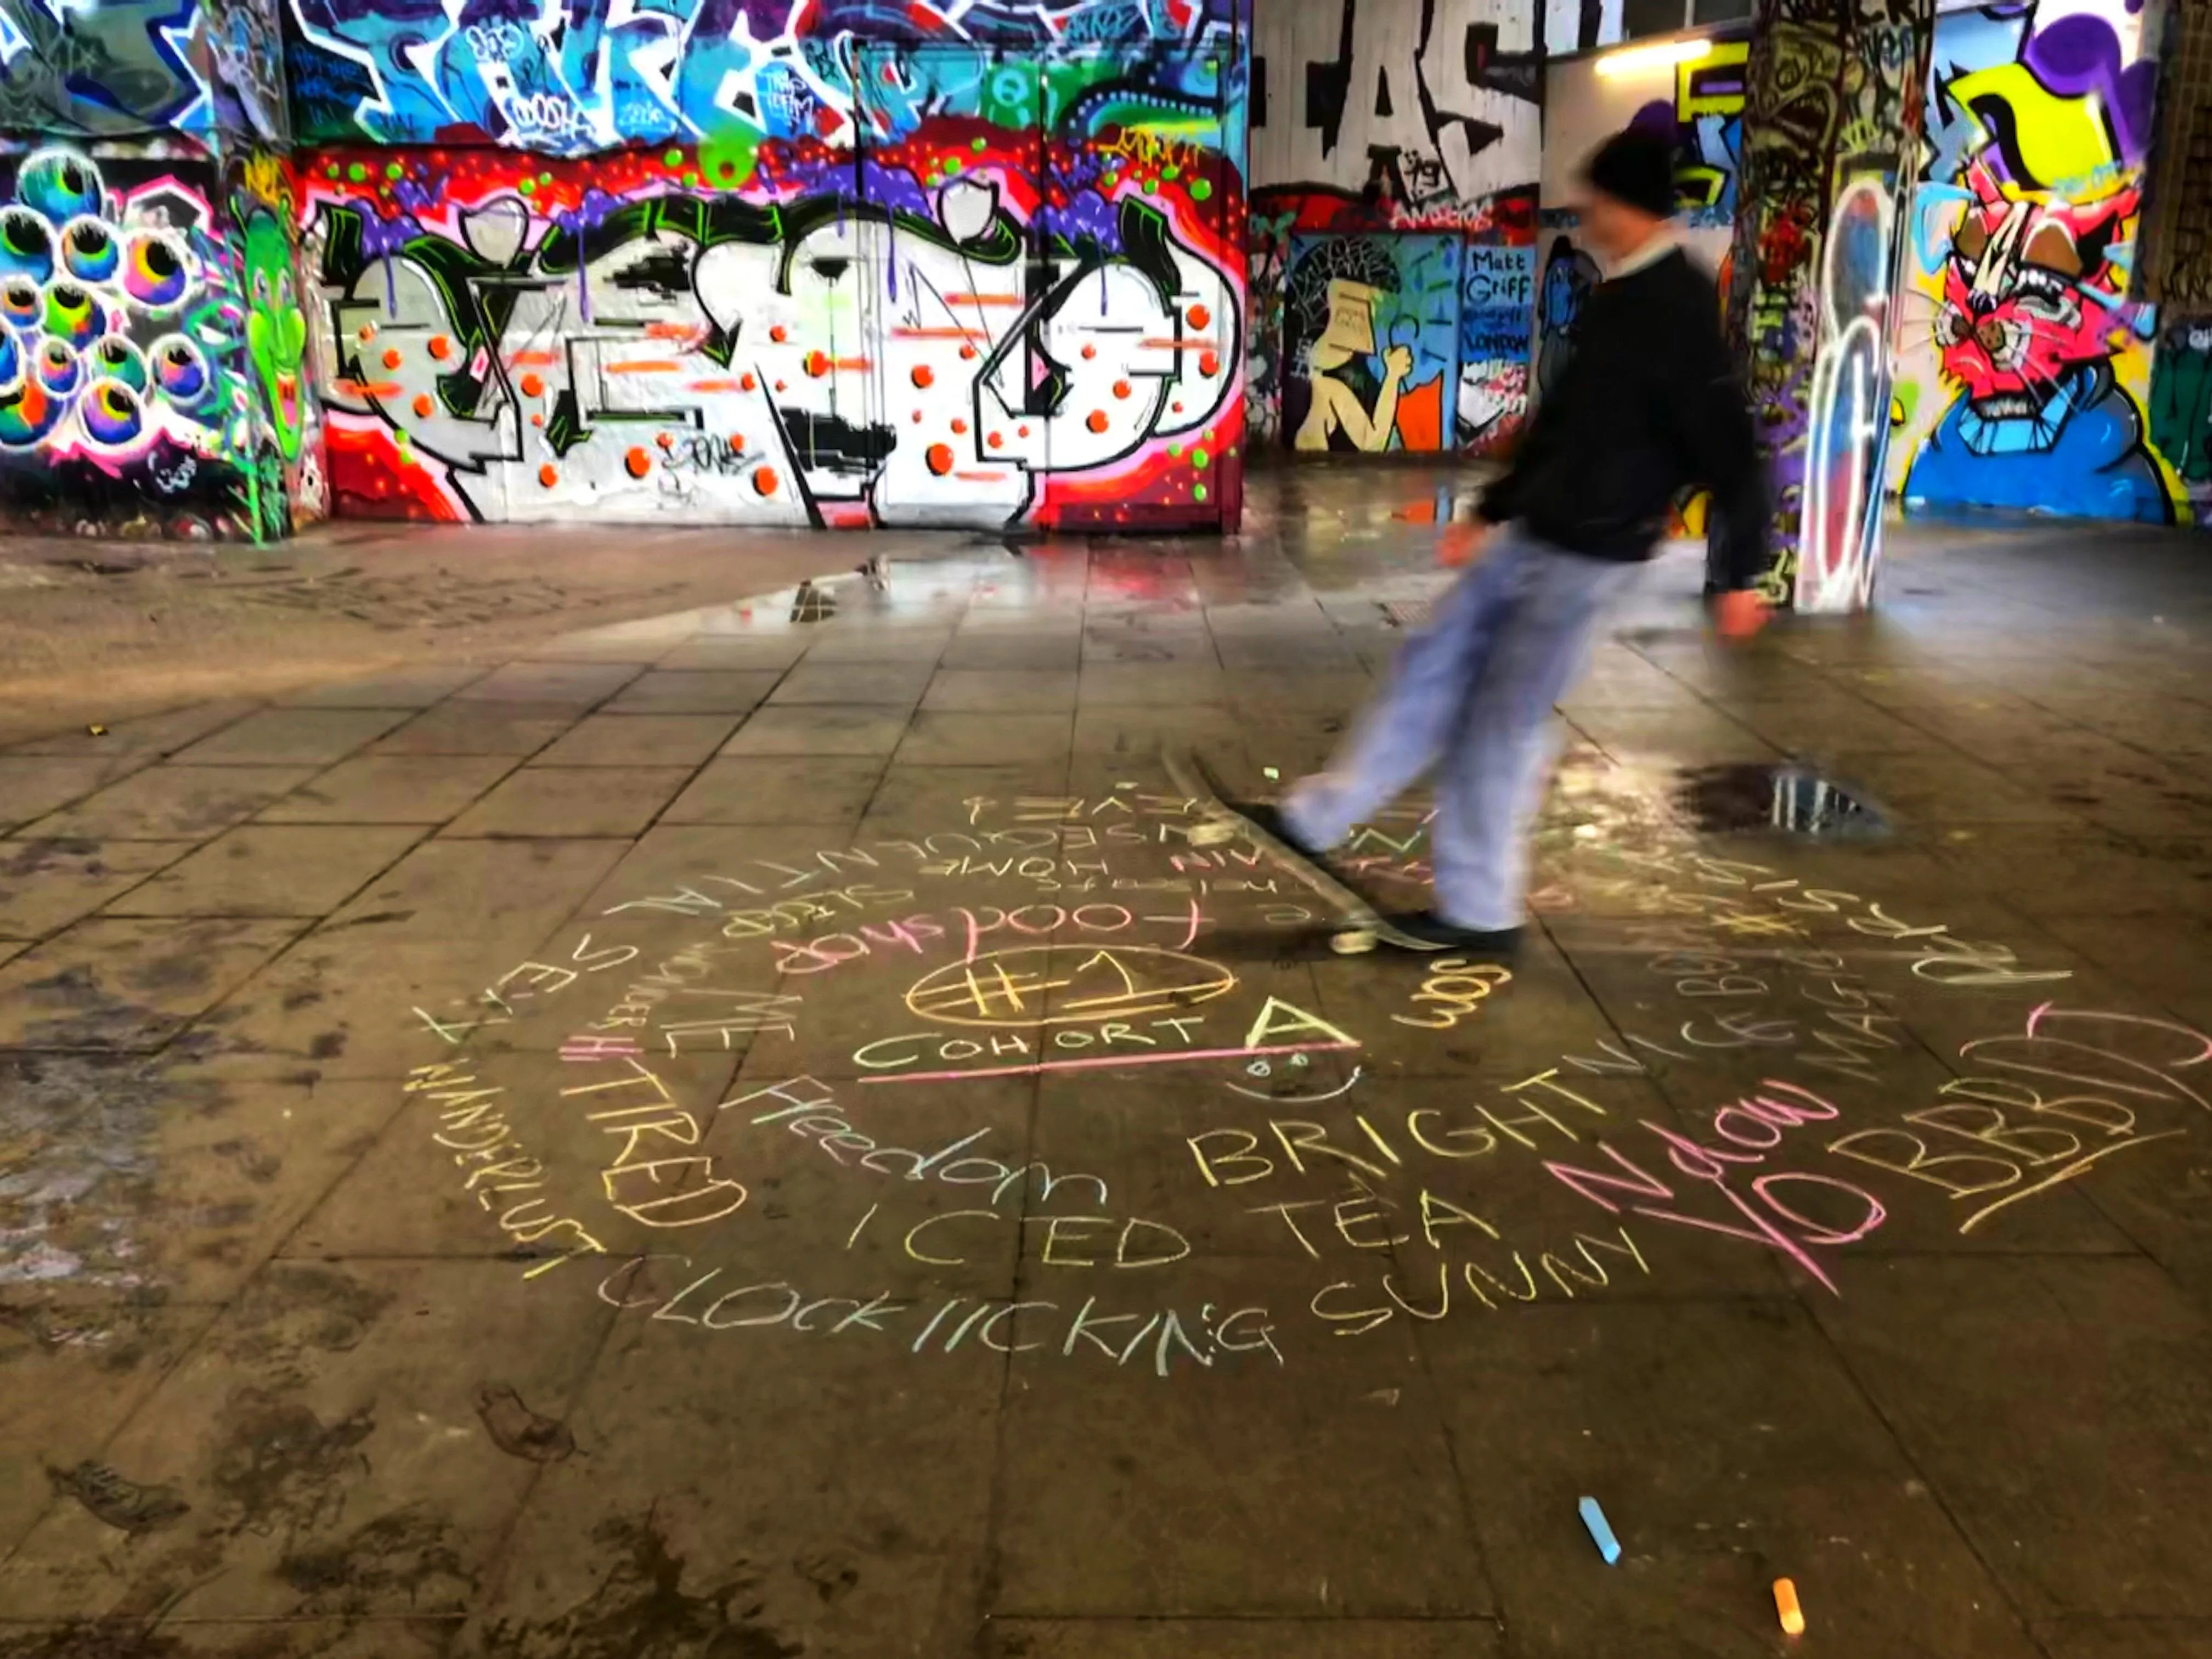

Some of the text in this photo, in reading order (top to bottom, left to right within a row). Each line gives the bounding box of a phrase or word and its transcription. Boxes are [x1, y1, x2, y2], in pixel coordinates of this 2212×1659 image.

[1466, 274, 1531, 304] Griff
[1472, 250, 1526, 272] Matt
[1244, 996, 1362, 1049] A
[560, 1057, 748, 1228] TIRED
[1187, 1068, 1609, 1188] BRIGHT
[846, 1204, 1192, 1268] ICED
[1243, 1185, 1502, 1261] TEA
[597, 1254, 909, 1334] CLOCK
